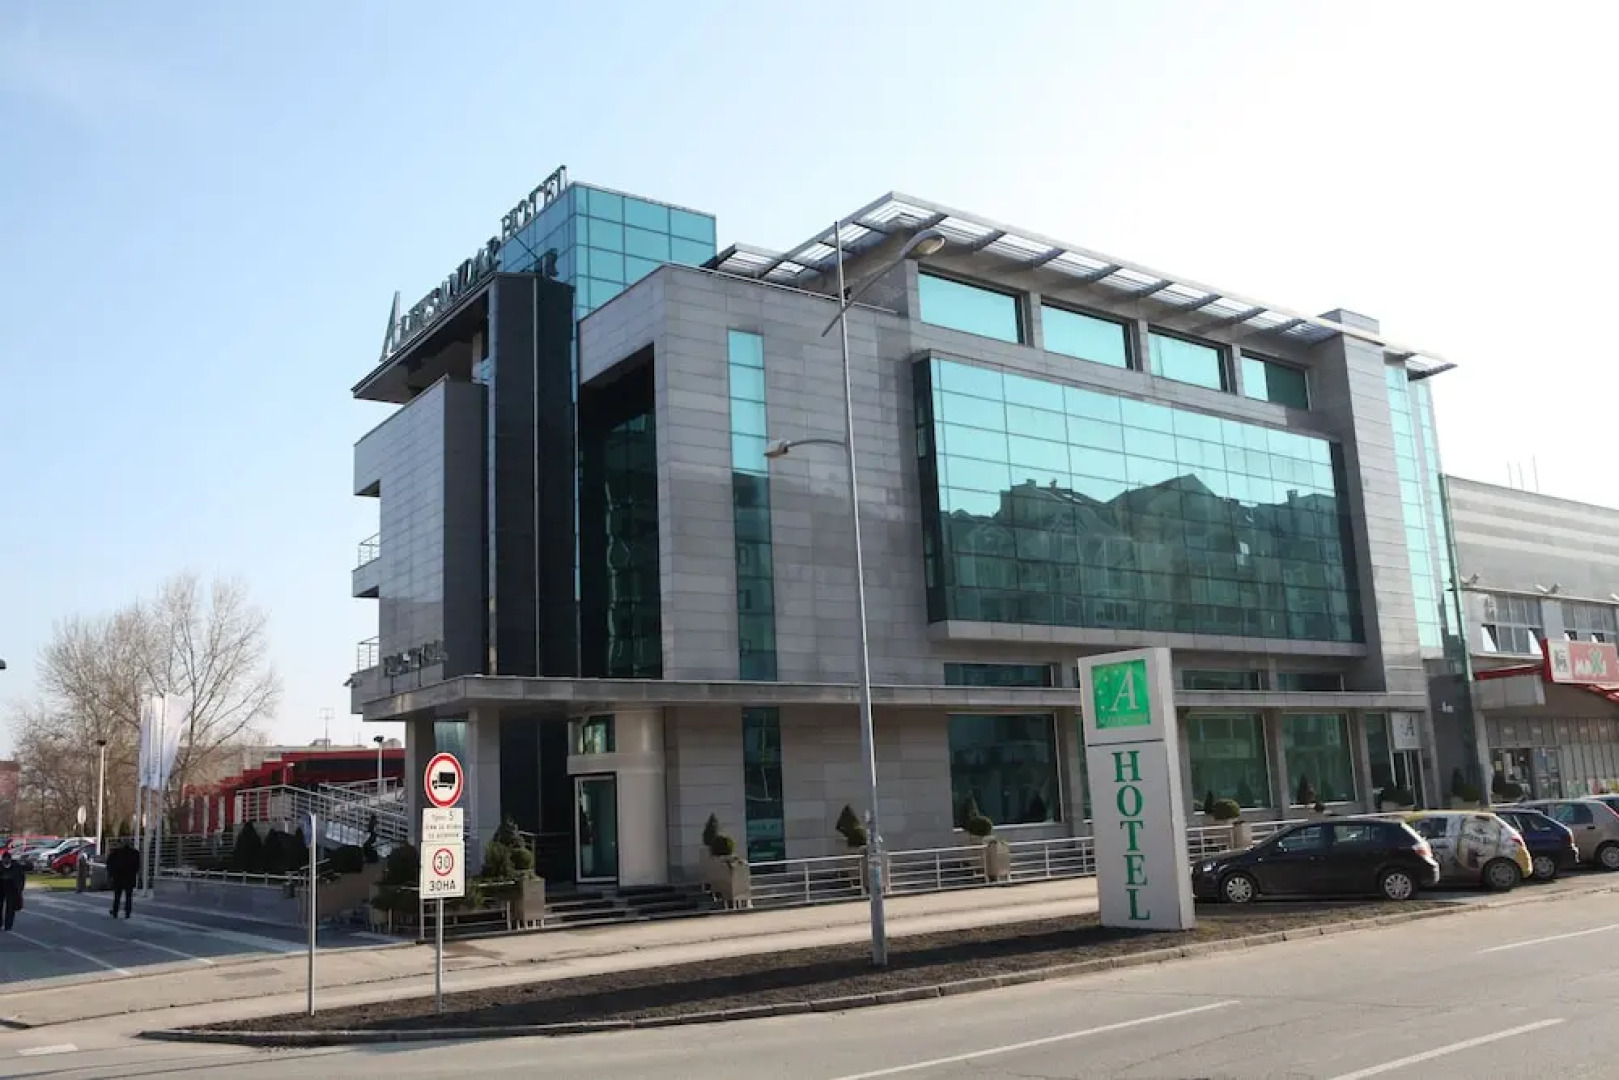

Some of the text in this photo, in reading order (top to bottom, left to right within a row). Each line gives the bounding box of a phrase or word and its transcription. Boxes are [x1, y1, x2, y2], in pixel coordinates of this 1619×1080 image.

[501, 165, 567, 243] HOTEL
[1108, 664, 1141, 712] A
[1111, 750, 1150, 921] HOTEL
[429, 879, 456, 892] ЗОНА
[436, 855, 451, 870] 30
